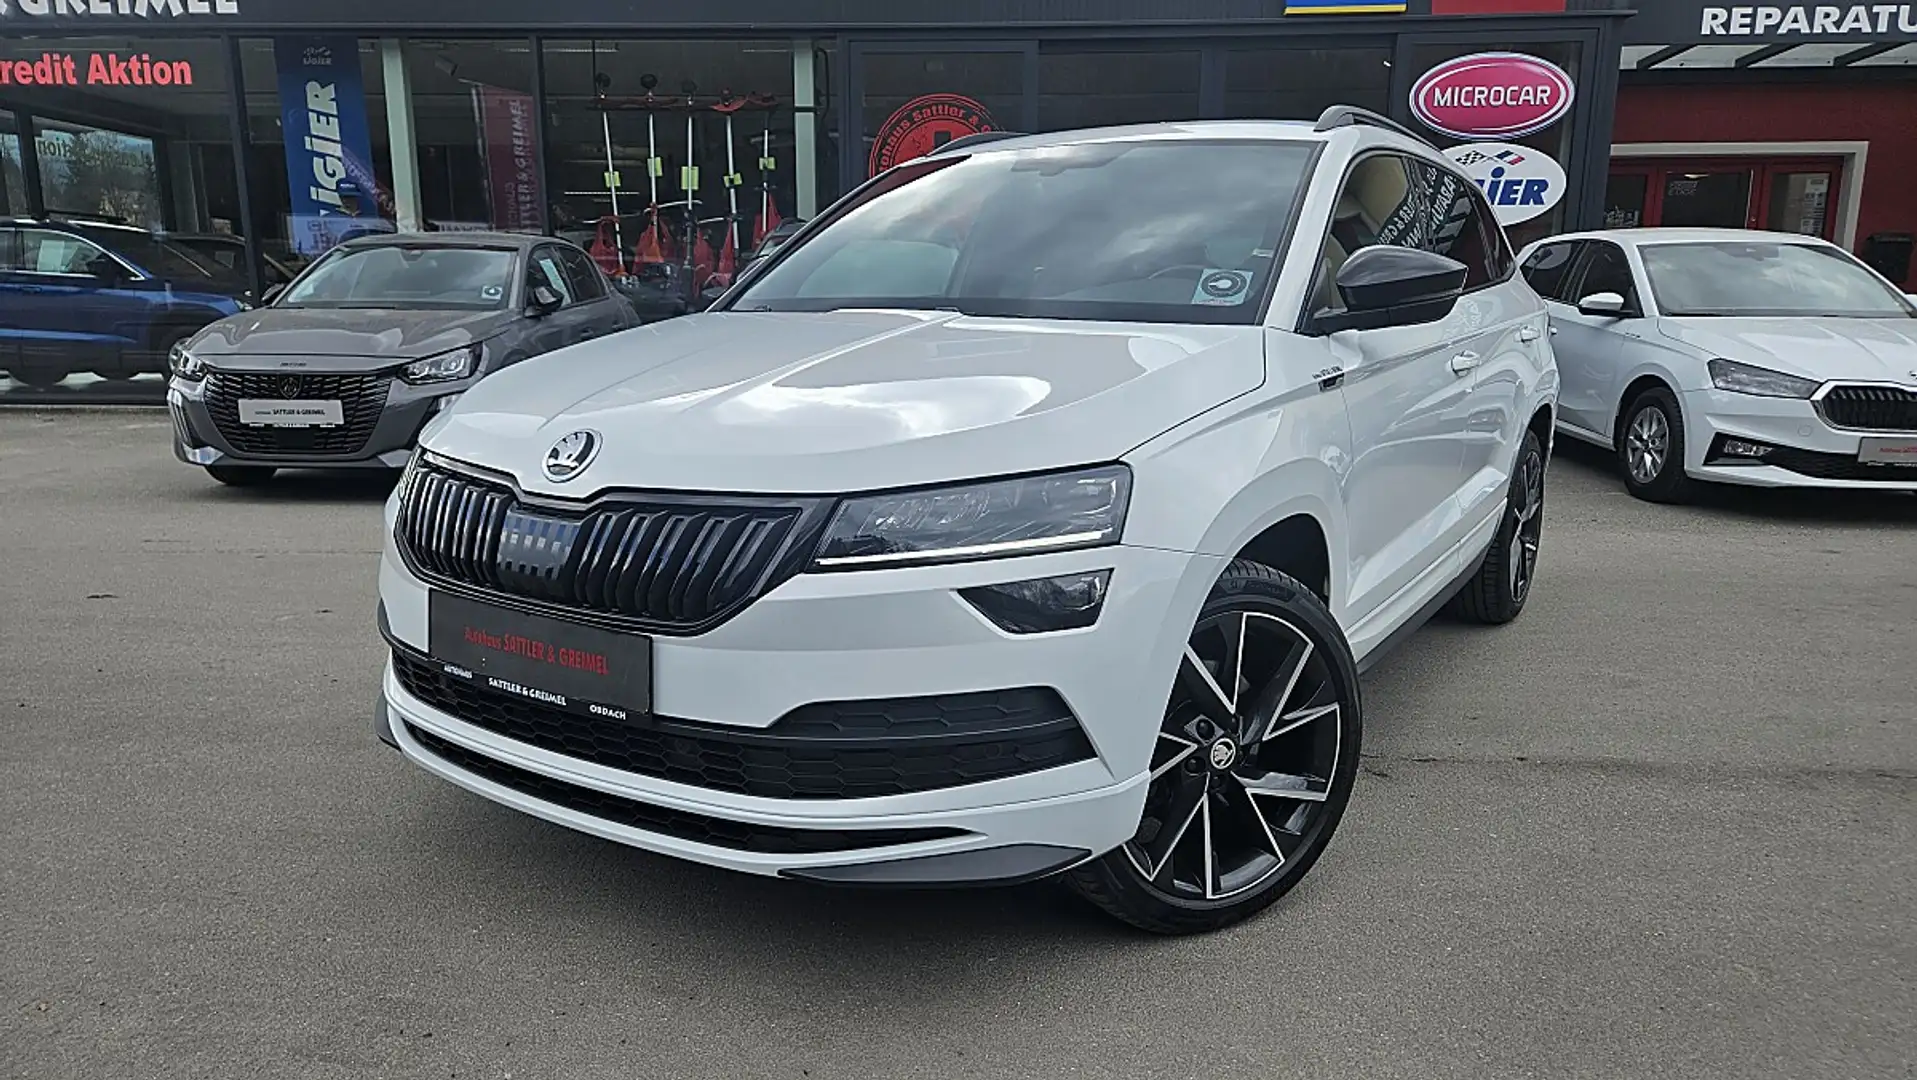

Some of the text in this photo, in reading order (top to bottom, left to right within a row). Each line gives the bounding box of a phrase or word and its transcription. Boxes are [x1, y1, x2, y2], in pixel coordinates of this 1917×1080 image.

[1701, 5, 1917, 35] REPARATU
[87, 53, 193, 86] Aktion
[1433, 85, 1551, 107] MICROCAR
[503, 633, 545, 660] SATTLER
[547, 644, 556, 664] &
[559, 647, 609, 675] GREIMEL
[488, 677, 522, 694] SATTLER
[528, 688, 567, 706] GREIMEL
